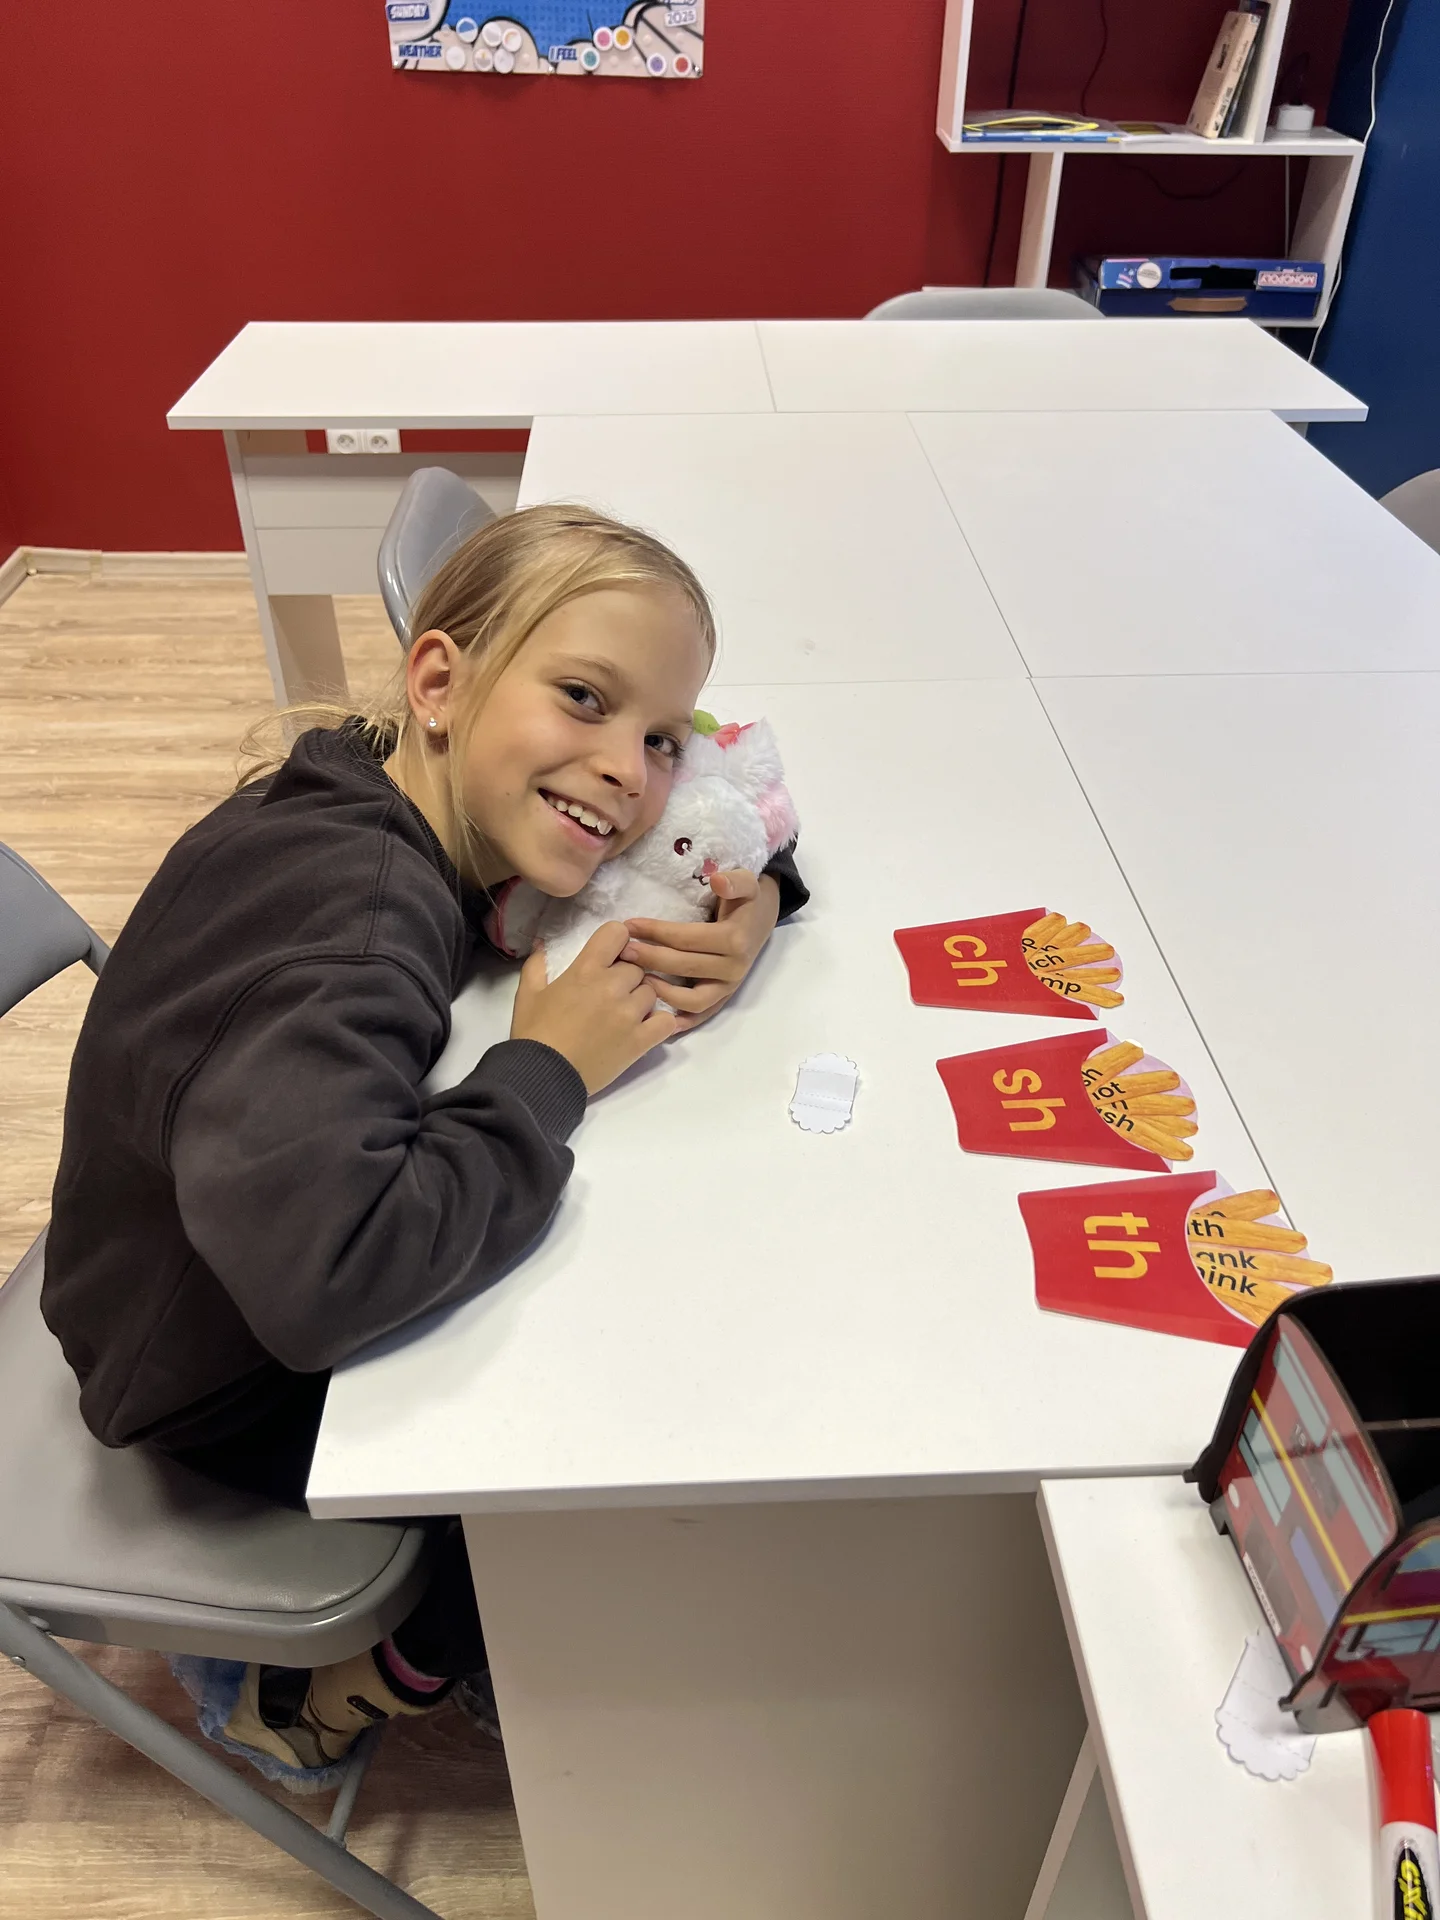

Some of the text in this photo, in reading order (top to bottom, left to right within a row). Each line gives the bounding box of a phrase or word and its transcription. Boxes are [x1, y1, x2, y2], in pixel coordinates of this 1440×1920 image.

[390, 4, 427, 18] SUNDAY
[668, 11, 694, 24] 2025
[399, 45, 442, 57] WEATHER
[557, 48, 577, 60] FEEL
[1260, 273, 1315, 285] MONOPOLY
[944, 935, 1007, 986] ch
[993, 1069, 1066, 1131] sh
[1084, 1212, 1160, 1279] th
